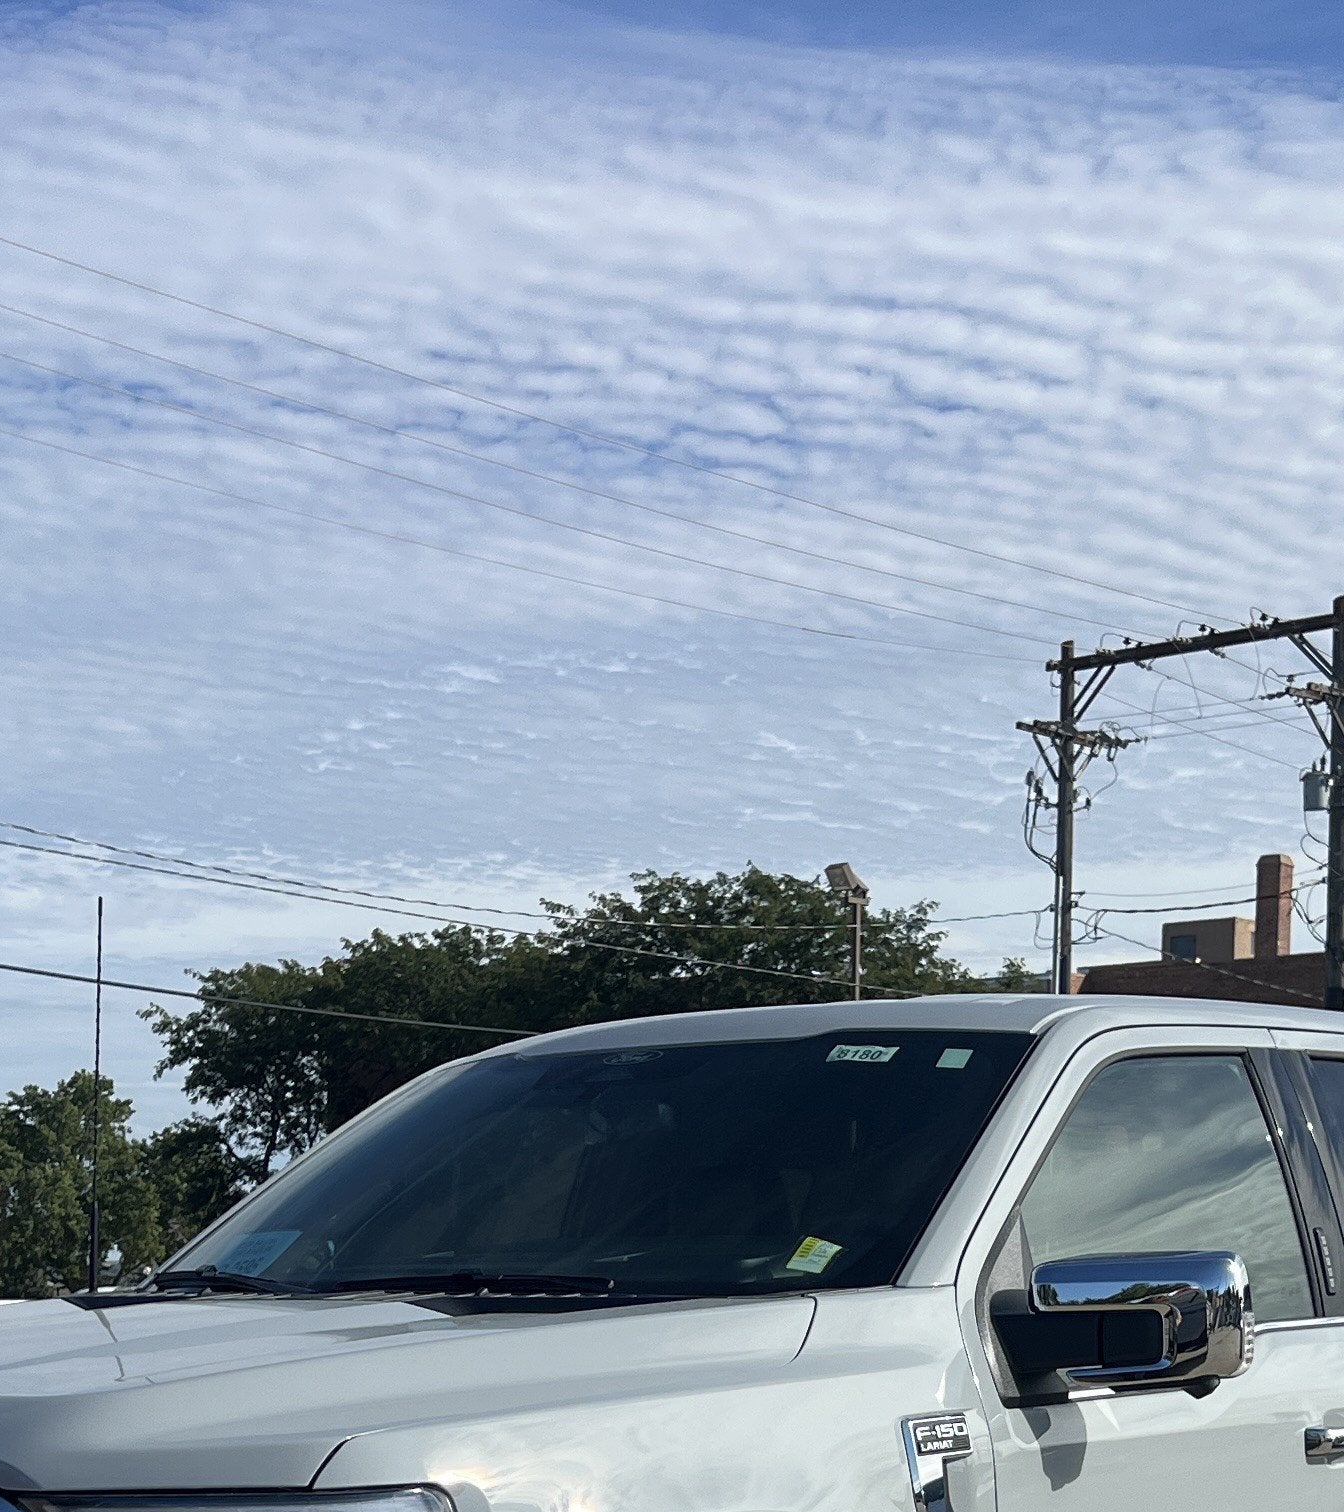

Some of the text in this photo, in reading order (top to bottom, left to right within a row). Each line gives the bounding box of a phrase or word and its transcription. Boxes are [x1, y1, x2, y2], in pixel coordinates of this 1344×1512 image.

[836, 1048, 883, 1060] 8180
[916, 1422, 968, 1440] F-150
[920, 1440, 953, 1452] LARIAT
